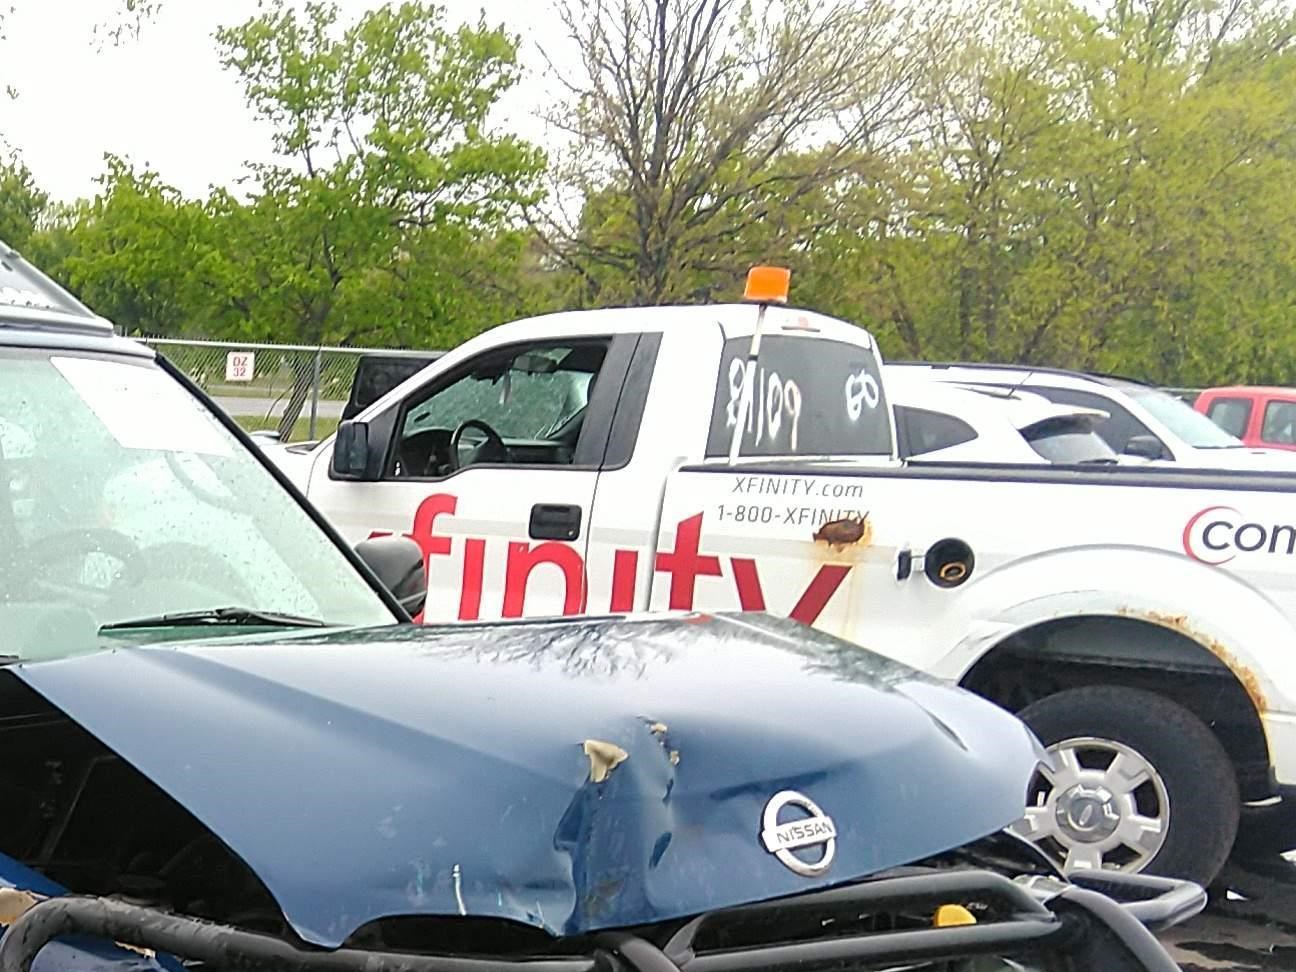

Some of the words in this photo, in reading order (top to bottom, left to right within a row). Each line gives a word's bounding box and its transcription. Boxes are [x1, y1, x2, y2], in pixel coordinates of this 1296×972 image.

[732, 477, 864, 498] XFINITY.com
[368, 493, 853, 626] finity
[776, 822, 833, 843] NISSAN
